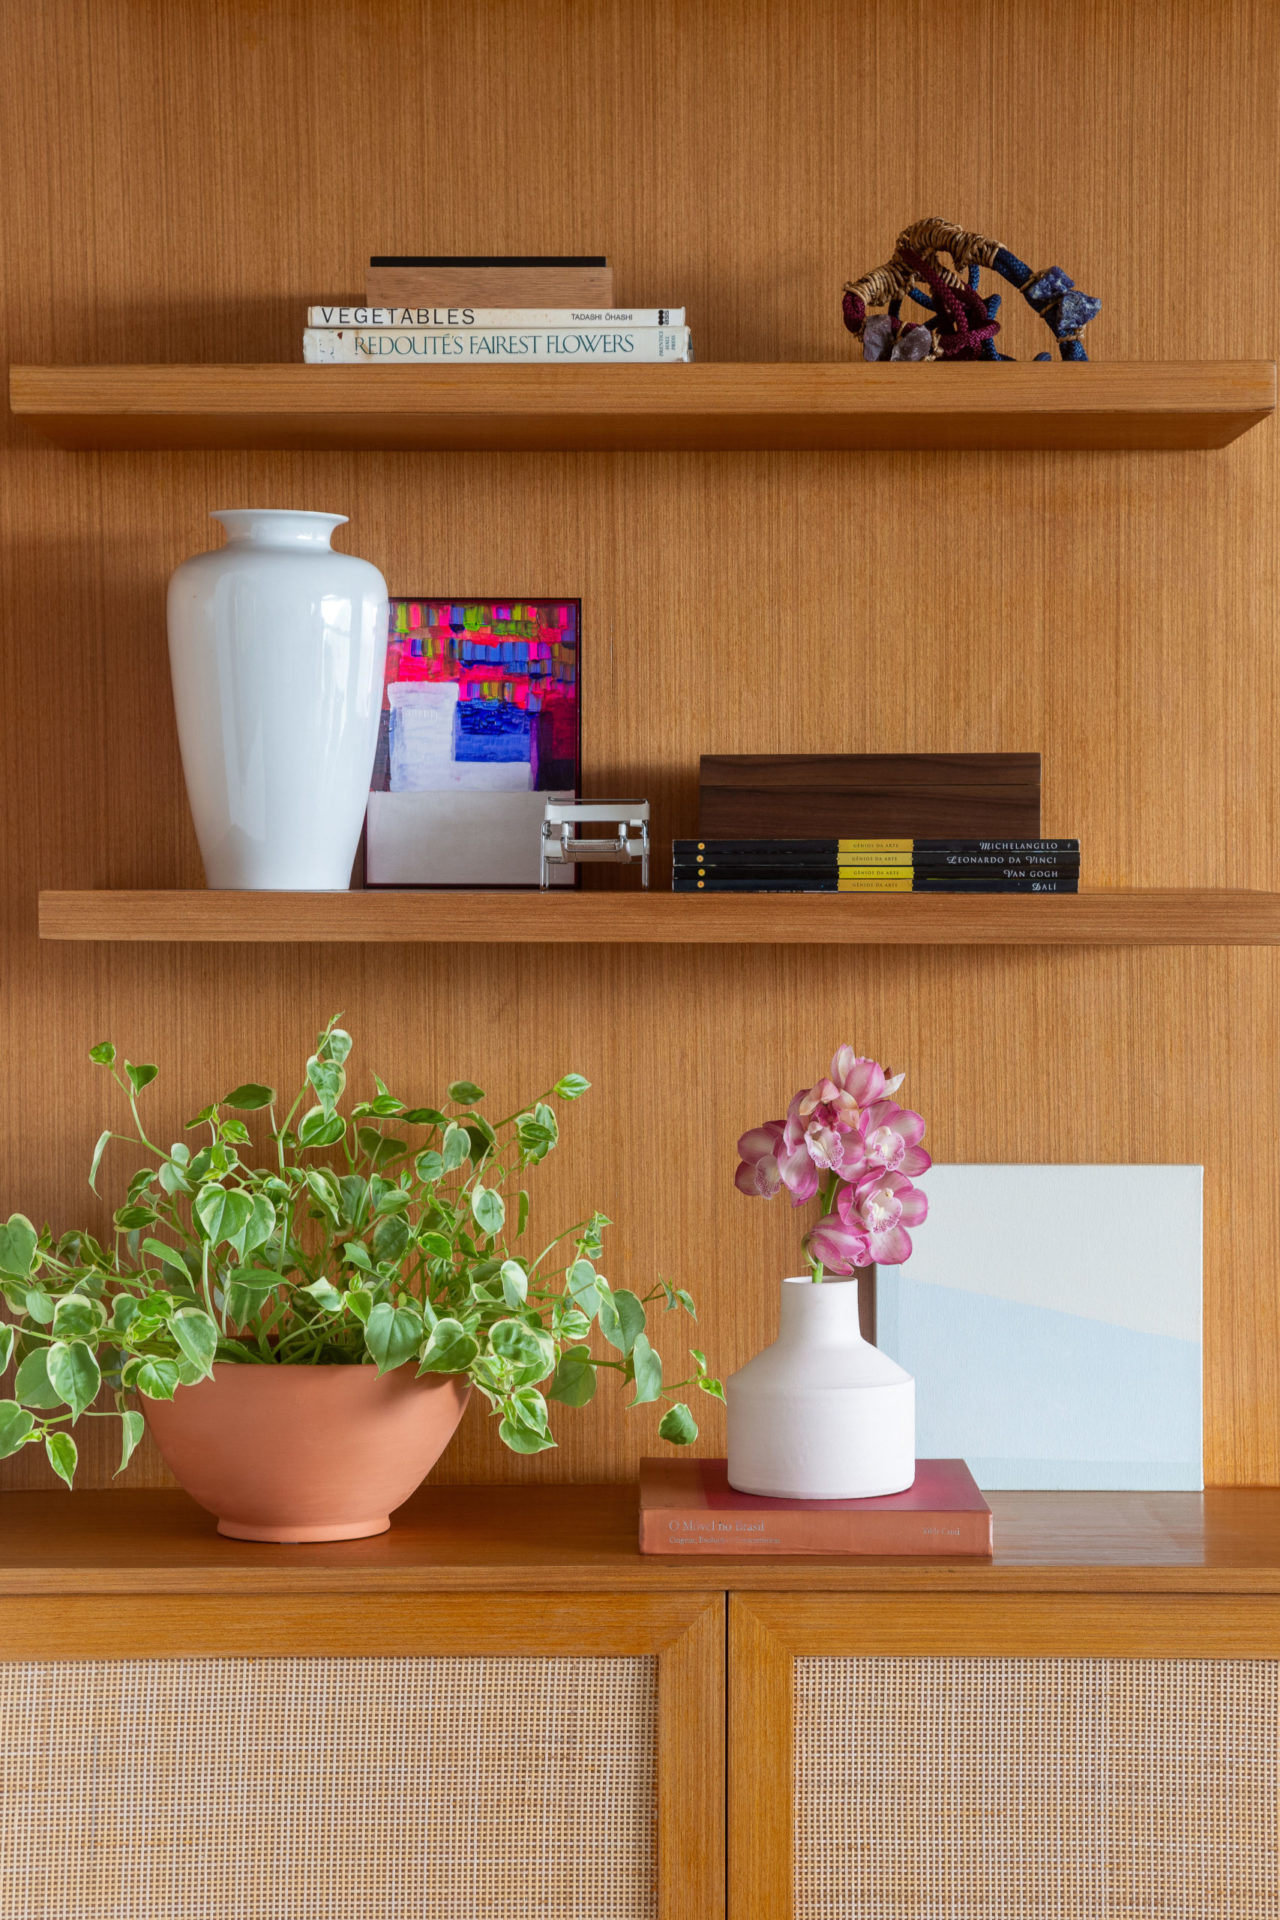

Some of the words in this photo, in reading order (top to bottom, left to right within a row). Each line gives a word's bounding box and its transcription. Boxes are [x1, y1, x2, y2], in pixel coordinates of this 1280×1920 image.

[321, 308, 475, 325] VEGETABLES
[571, 313, 602, 321] TADASHI
[469, 335, 542, 355] FAIREST
[547, 334, 634, 355] FLOWERS
[979, 842, 1058, 850] MICHELANGELO
[947, 856, 1004, 864] LEONARDO
[1025, 856, 1057, 864] VINCI
[1003, 869, 1026, 878] VAN
[1029, 870, 1059, 878] GOGH
[668, 1520, 680, 1532] O
[718, 1522, 733, 1532] no
